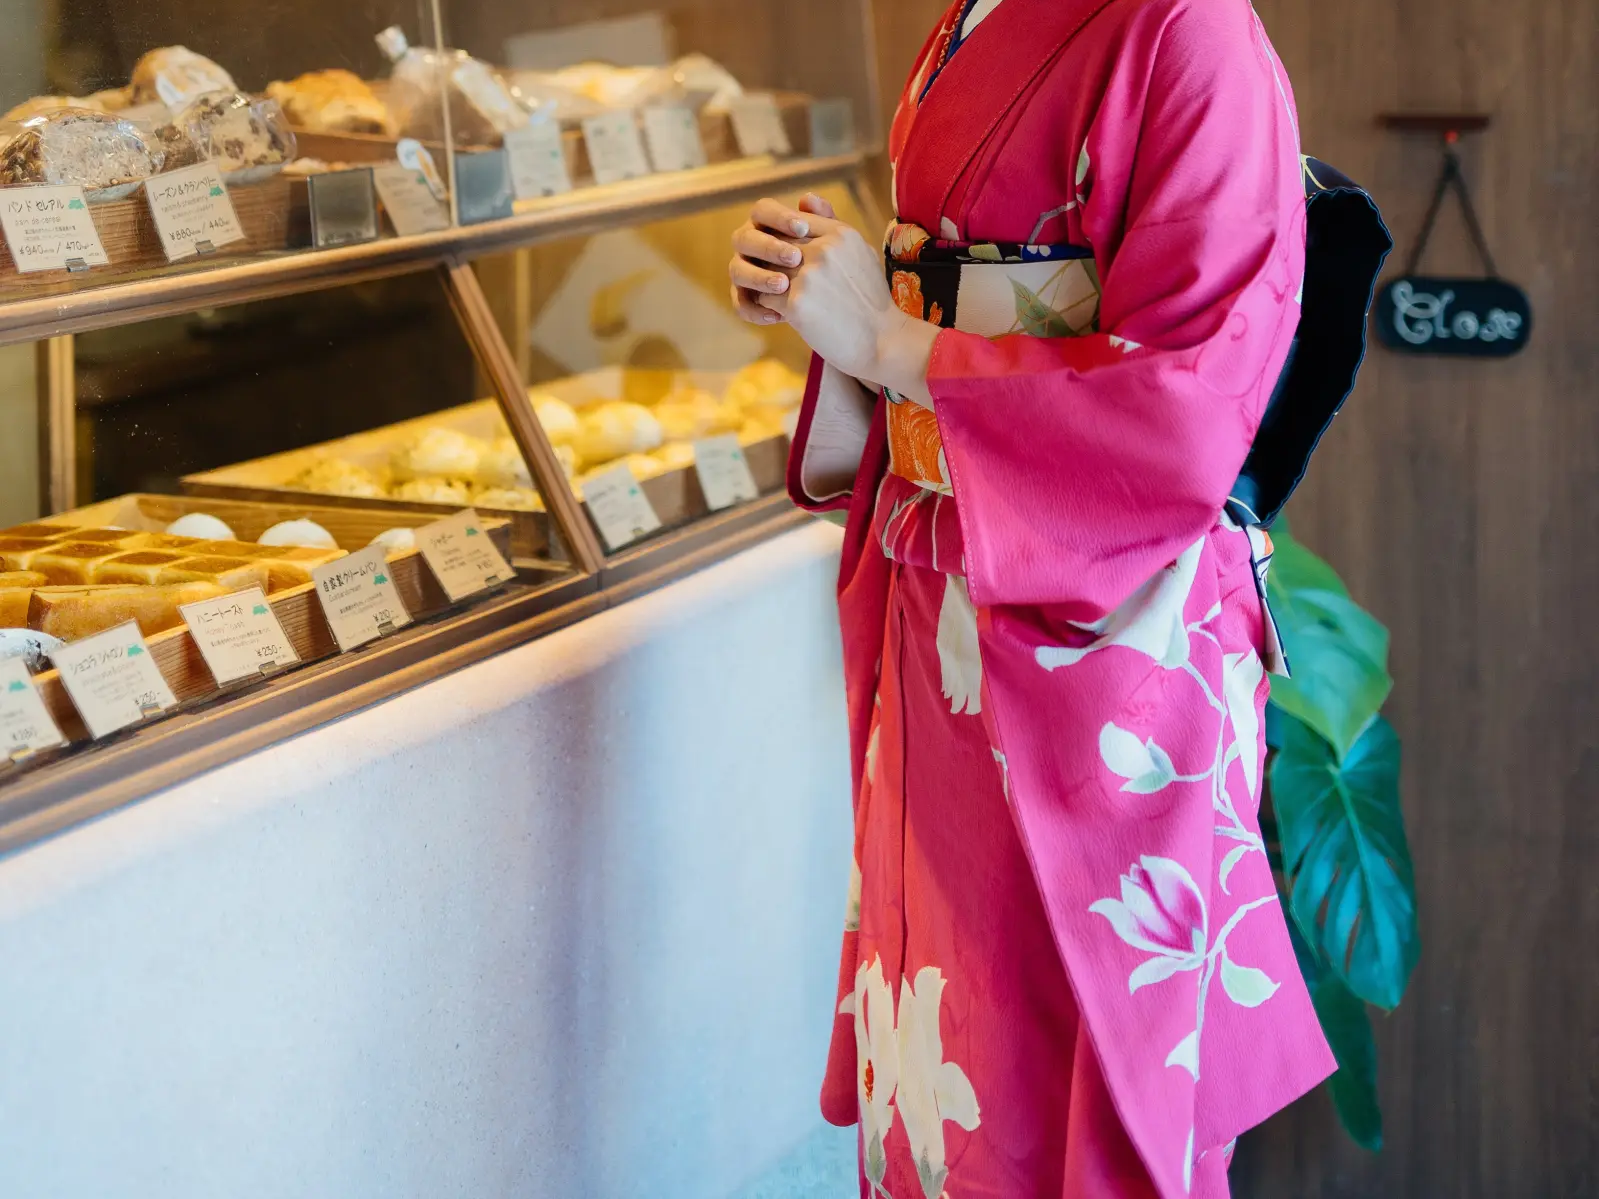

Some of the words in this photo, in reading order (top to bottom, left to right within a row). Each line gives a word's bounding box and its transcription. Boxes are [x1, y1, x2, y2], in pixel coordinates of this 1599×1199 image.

[1391, 280, 1522, 345] Close
[197, 604, 243, 624] ハニートースト
